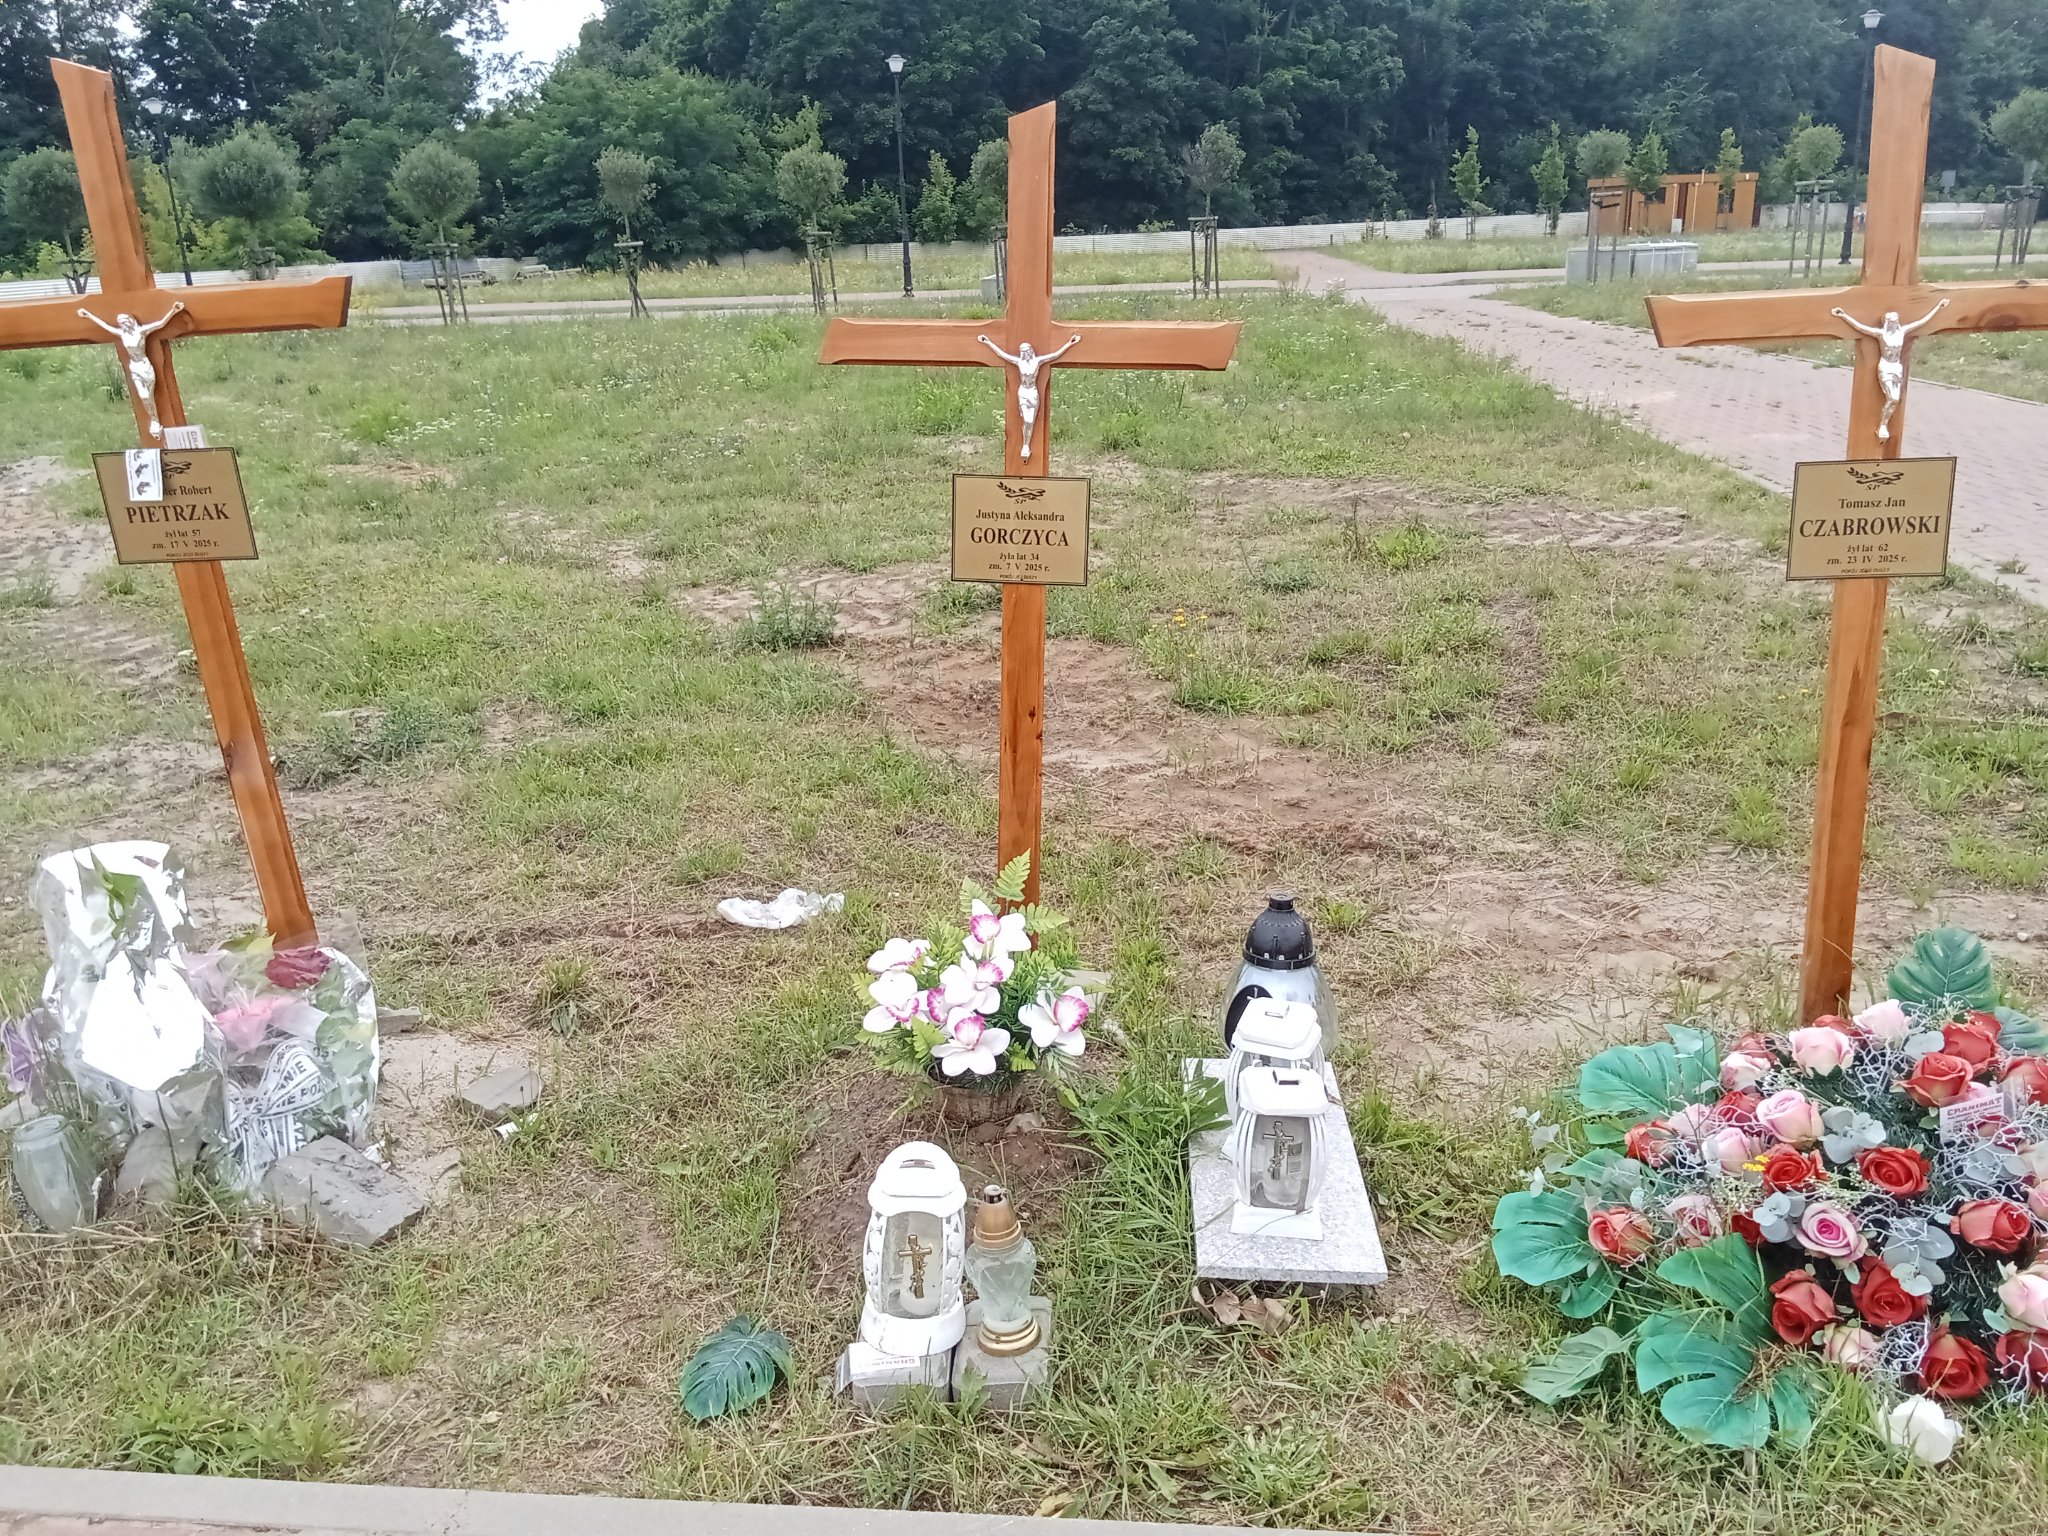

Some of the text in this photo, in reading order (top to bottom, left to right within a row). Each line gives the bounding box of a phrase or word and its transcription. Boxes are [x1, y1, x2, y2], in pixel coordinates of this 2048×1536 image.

[179, 485, 212, 496] Robert
[1838, 496, 1906, 509] Tomasz Jan
[125, 503, 230, 524] PIETRZAK
[976, 509, 1065, 522] Justyna Aleksandra
[1799, 515, 1941, 538] CZABROWSKI
[192, 529, 201, 537] 57
[970, 527, 1069, 546] GORCZYCA
[182, 540, 191, 548] V
[193, 539, 212, 548] 2025
[1862, 544, 1873, 552] lat
[1878, 543, 1889, 552] 62
[1016, 552, 1027, 560] lat
[1030, 553, 1040, 561] 34
[1826, 557, 1842, 565] zm.
[1847, 556, 1857, 564] 23
[1862, 555, 1874, 564] IV
[1878, 554, 1899, 563] 2025
[1025, 563, 1043, 571] 2025
[1947, 1096, 2003, 1116] GRANIMAT
